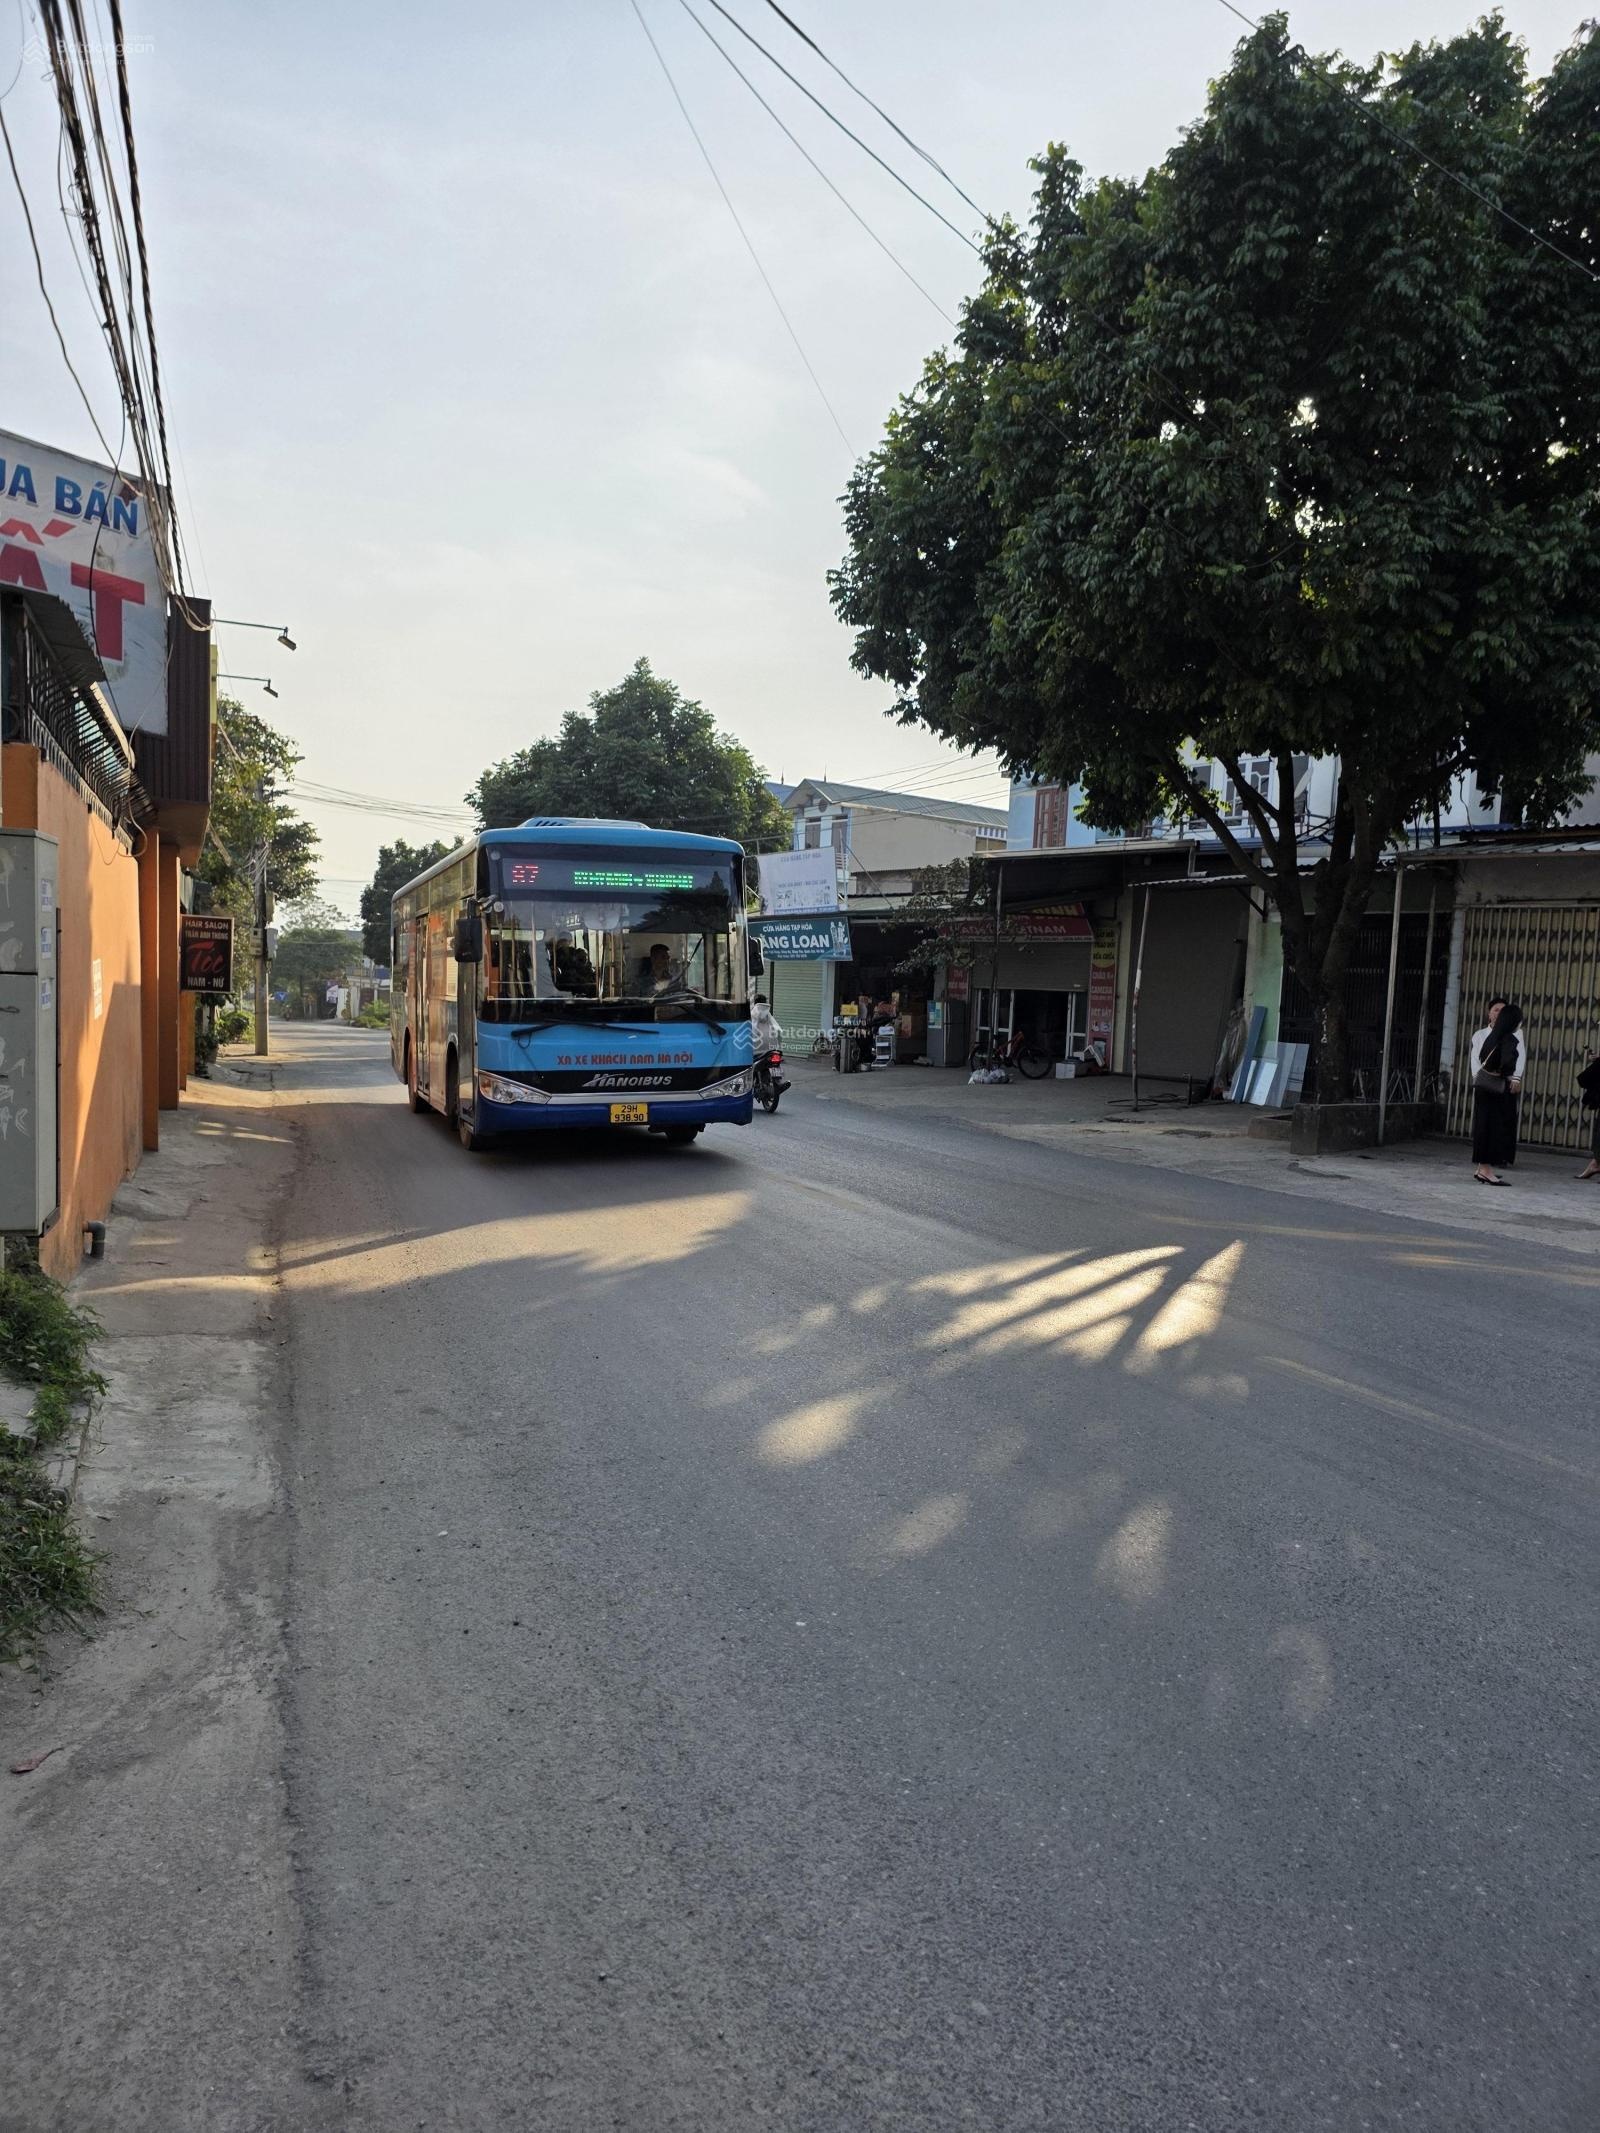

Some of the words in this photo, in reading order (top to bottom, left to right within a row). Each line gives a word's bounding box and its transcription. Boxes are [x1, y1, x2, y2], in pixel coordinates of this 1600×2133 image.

[54, 474, 138, 537] BÁN
[185, 920, 203, 929] HAIR
[204, 921, 229, 930] SALON
[791, 934, 830, 949] LOAN
[187, 976, 206, 987] NAM
[574, 1055, 588, 1066] XE
[582, 1074, 673, 1088] HANOIBUS
[621, 1104, 638, 1114] 29H
